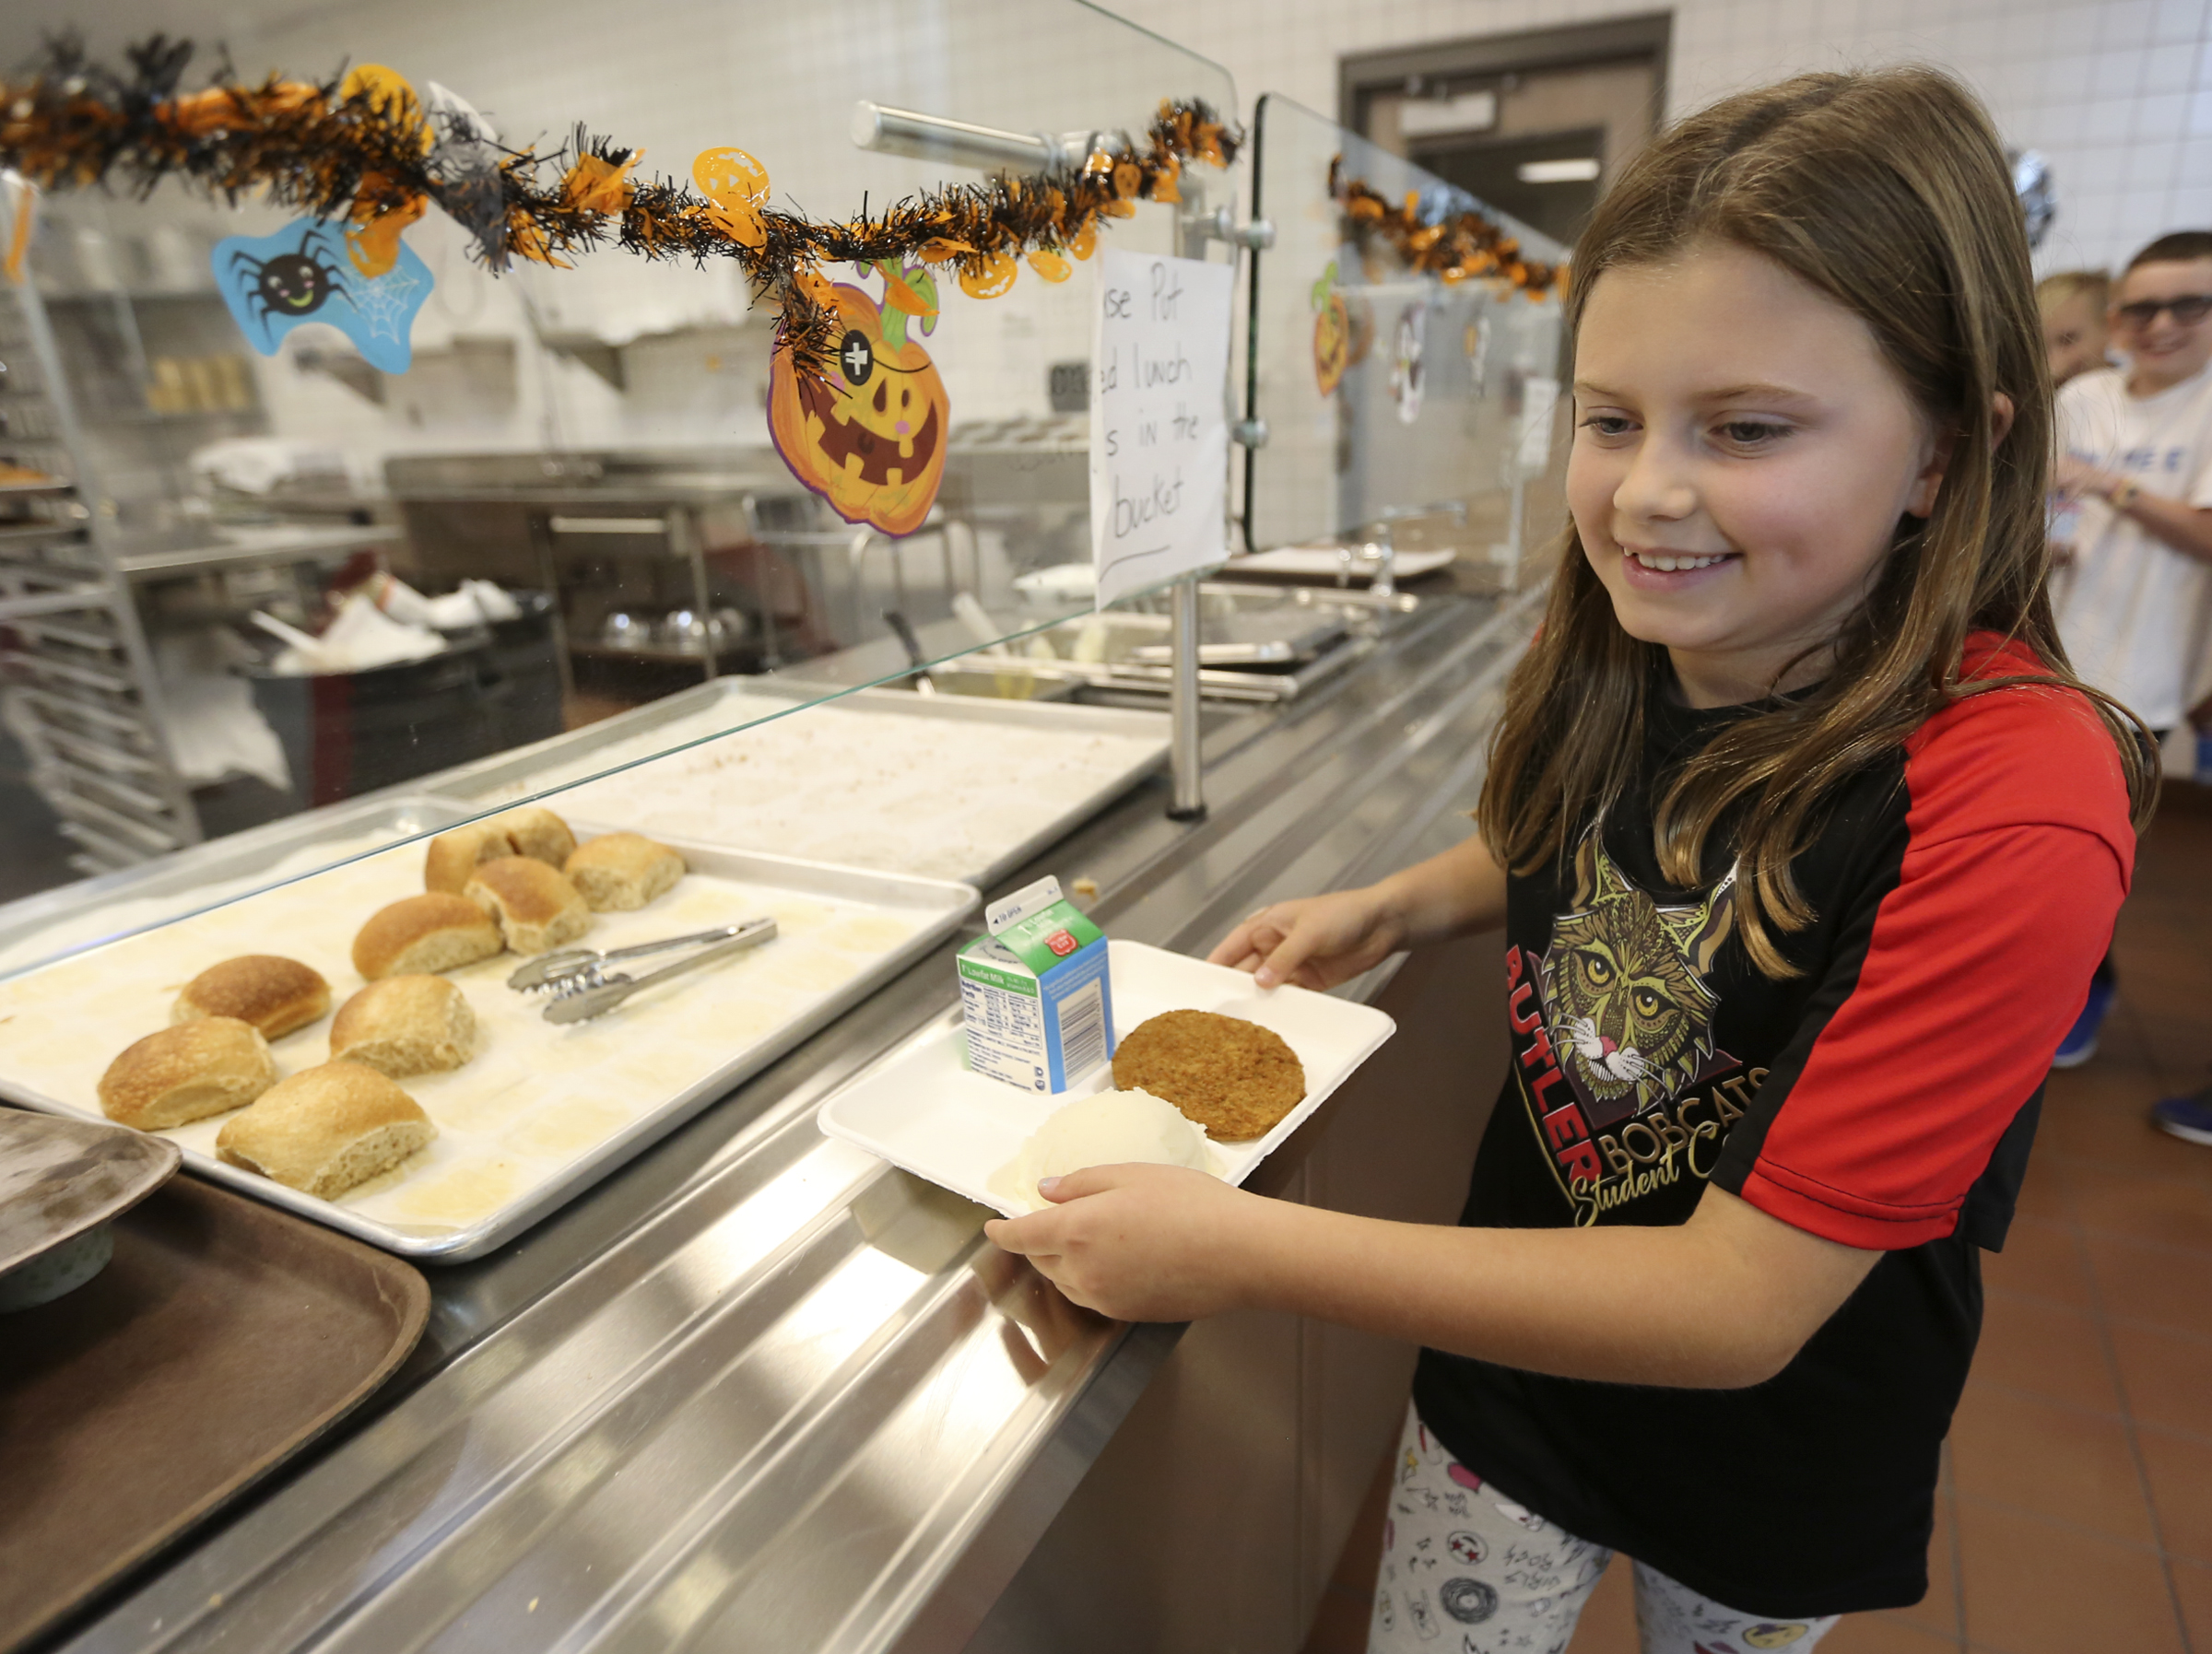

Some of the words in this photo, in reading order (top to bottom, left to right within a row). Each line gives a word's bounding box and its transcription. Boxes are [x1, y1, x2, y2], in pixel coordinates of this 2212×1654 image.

[1133, 340, 1193, 389] lunch
[1113, 464, 1184, 539] bucket
[1506, 944, 1603, 1184] BUTLER
[1571, 1143, 1679, 1227] Student
